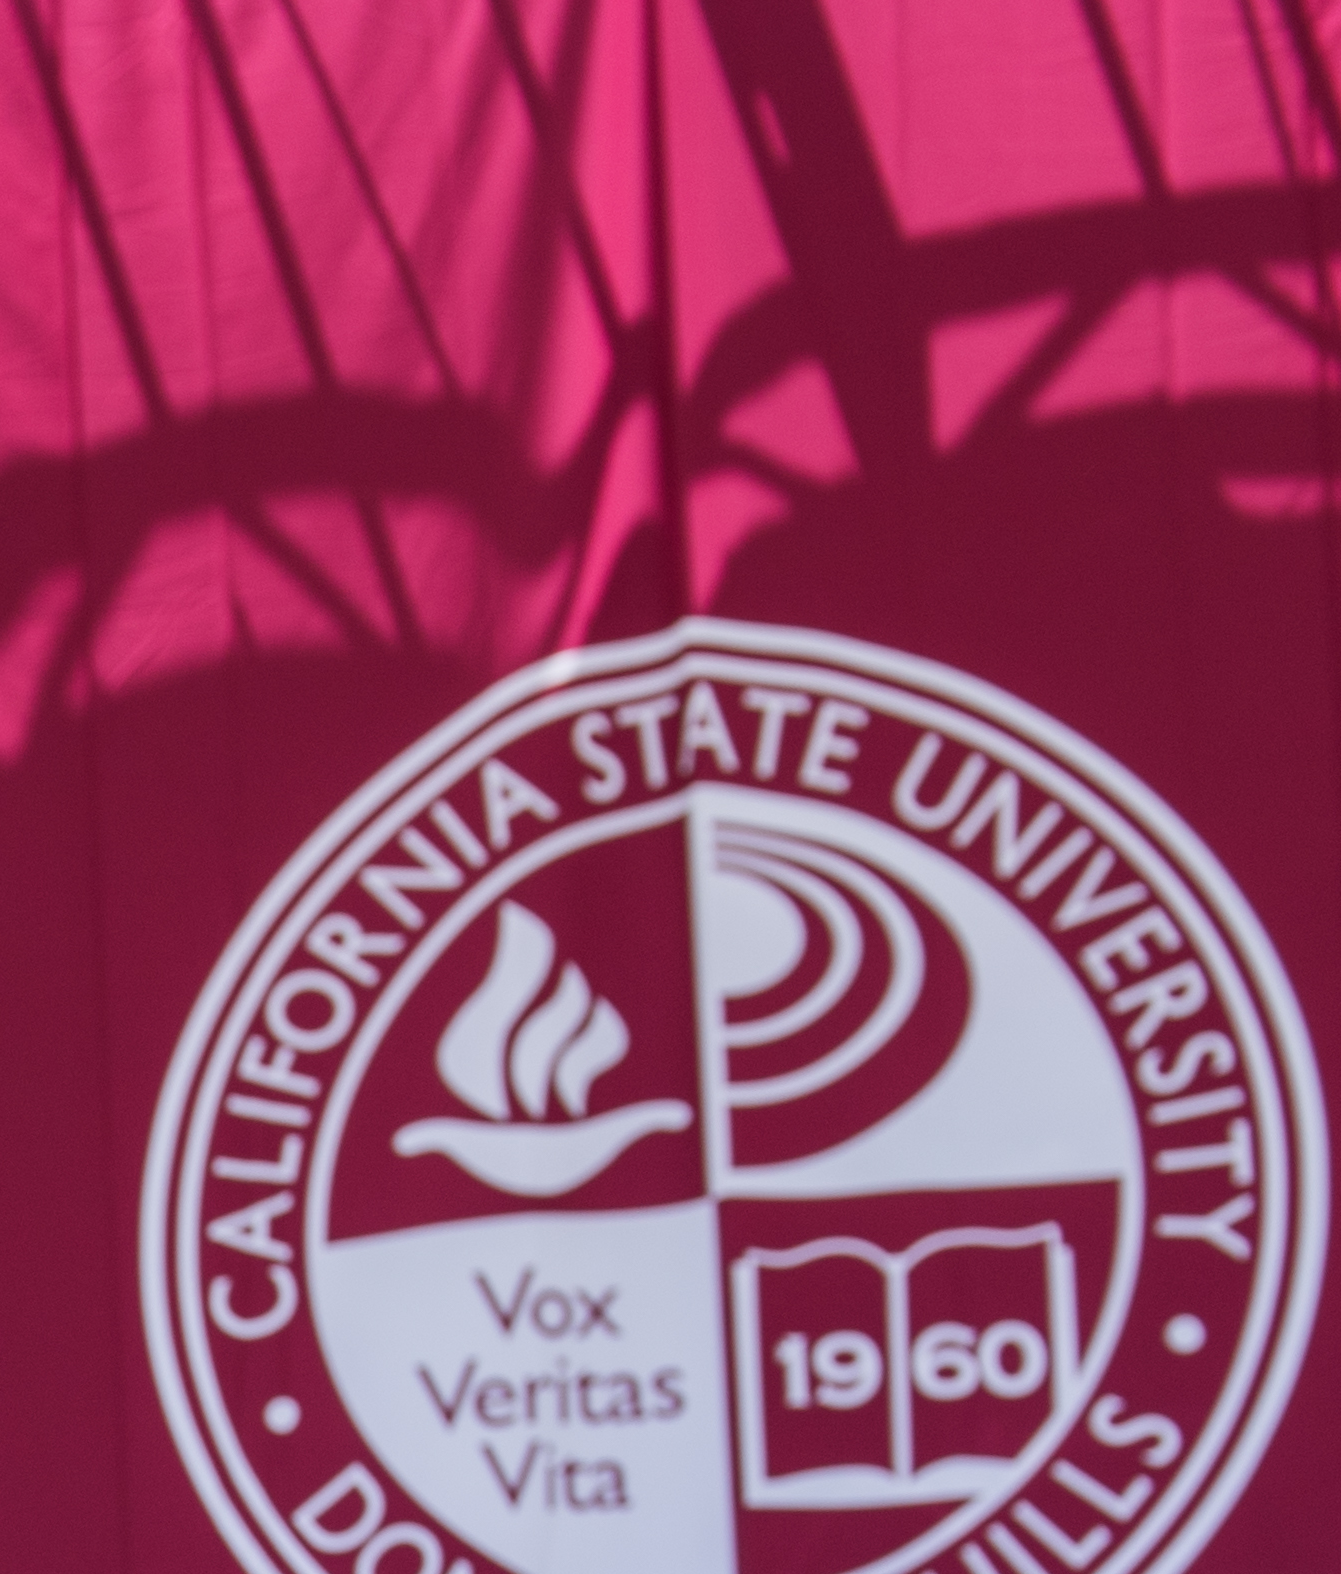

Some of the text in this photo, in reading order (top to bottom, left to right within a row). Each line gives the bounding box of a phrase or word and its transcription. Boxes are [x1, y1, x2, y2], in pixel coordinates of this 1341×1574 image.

[206, 681, 1257, 1342] CALIFORNIA STATE UNIVERSITY
[473, 1266, 622, 1340] Vox
[416, 1354, 688, 1429] Veritas
[480, 1437, 633, 1513] Vita
